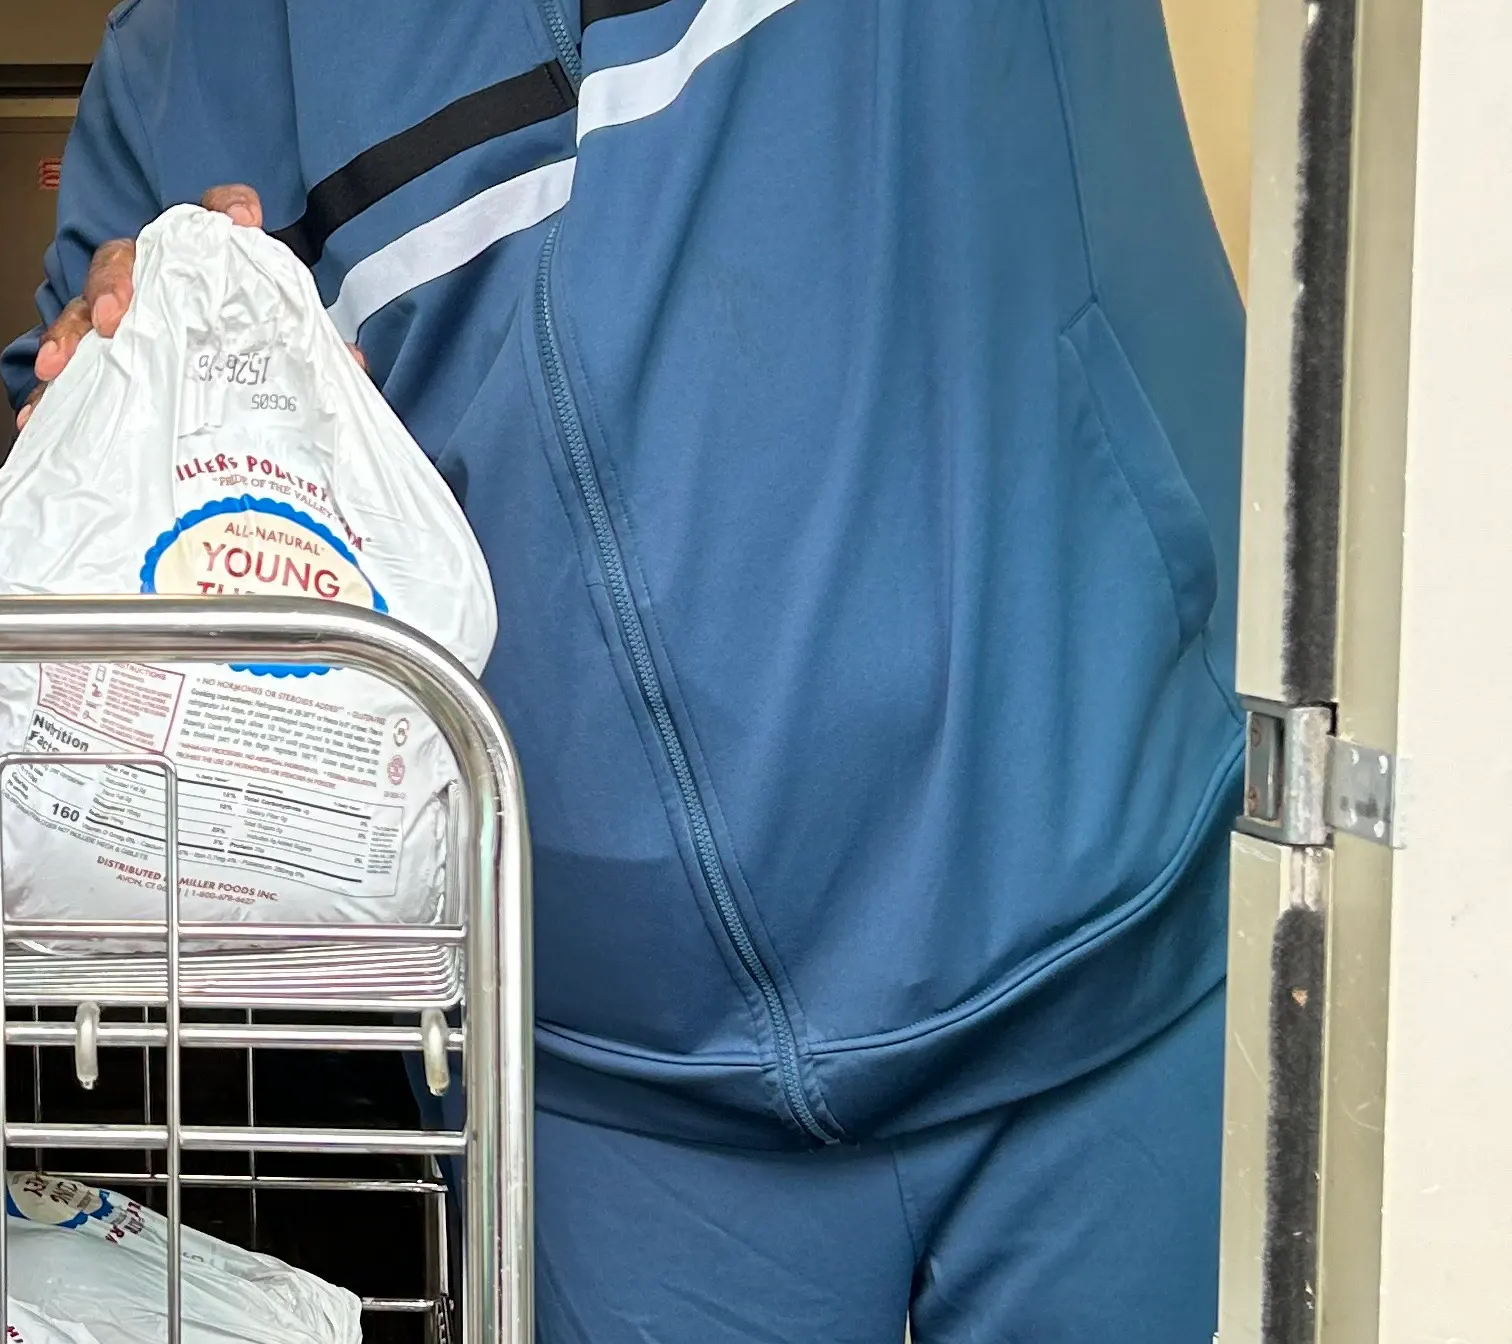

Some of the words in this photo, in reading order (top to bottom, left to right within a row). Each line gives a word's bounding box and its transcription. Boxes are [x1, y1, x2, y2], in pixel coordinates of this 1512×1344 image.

[251, 478, 266, 488] OF
[268, 481, 291, 495] THE
[202, 541, 341, 598] YOUNG
[202, 678, 215, 686] NO
[265, 689, 276, 698] OR
[33, 713, 90, 752] Nutrition
[52, 803, 80, 822] 160
[96, 855, 162, 881] DISTRIBUTED
[179, 877, 215, 890] MILLER
[218, 882, 255, 896] FOODS
